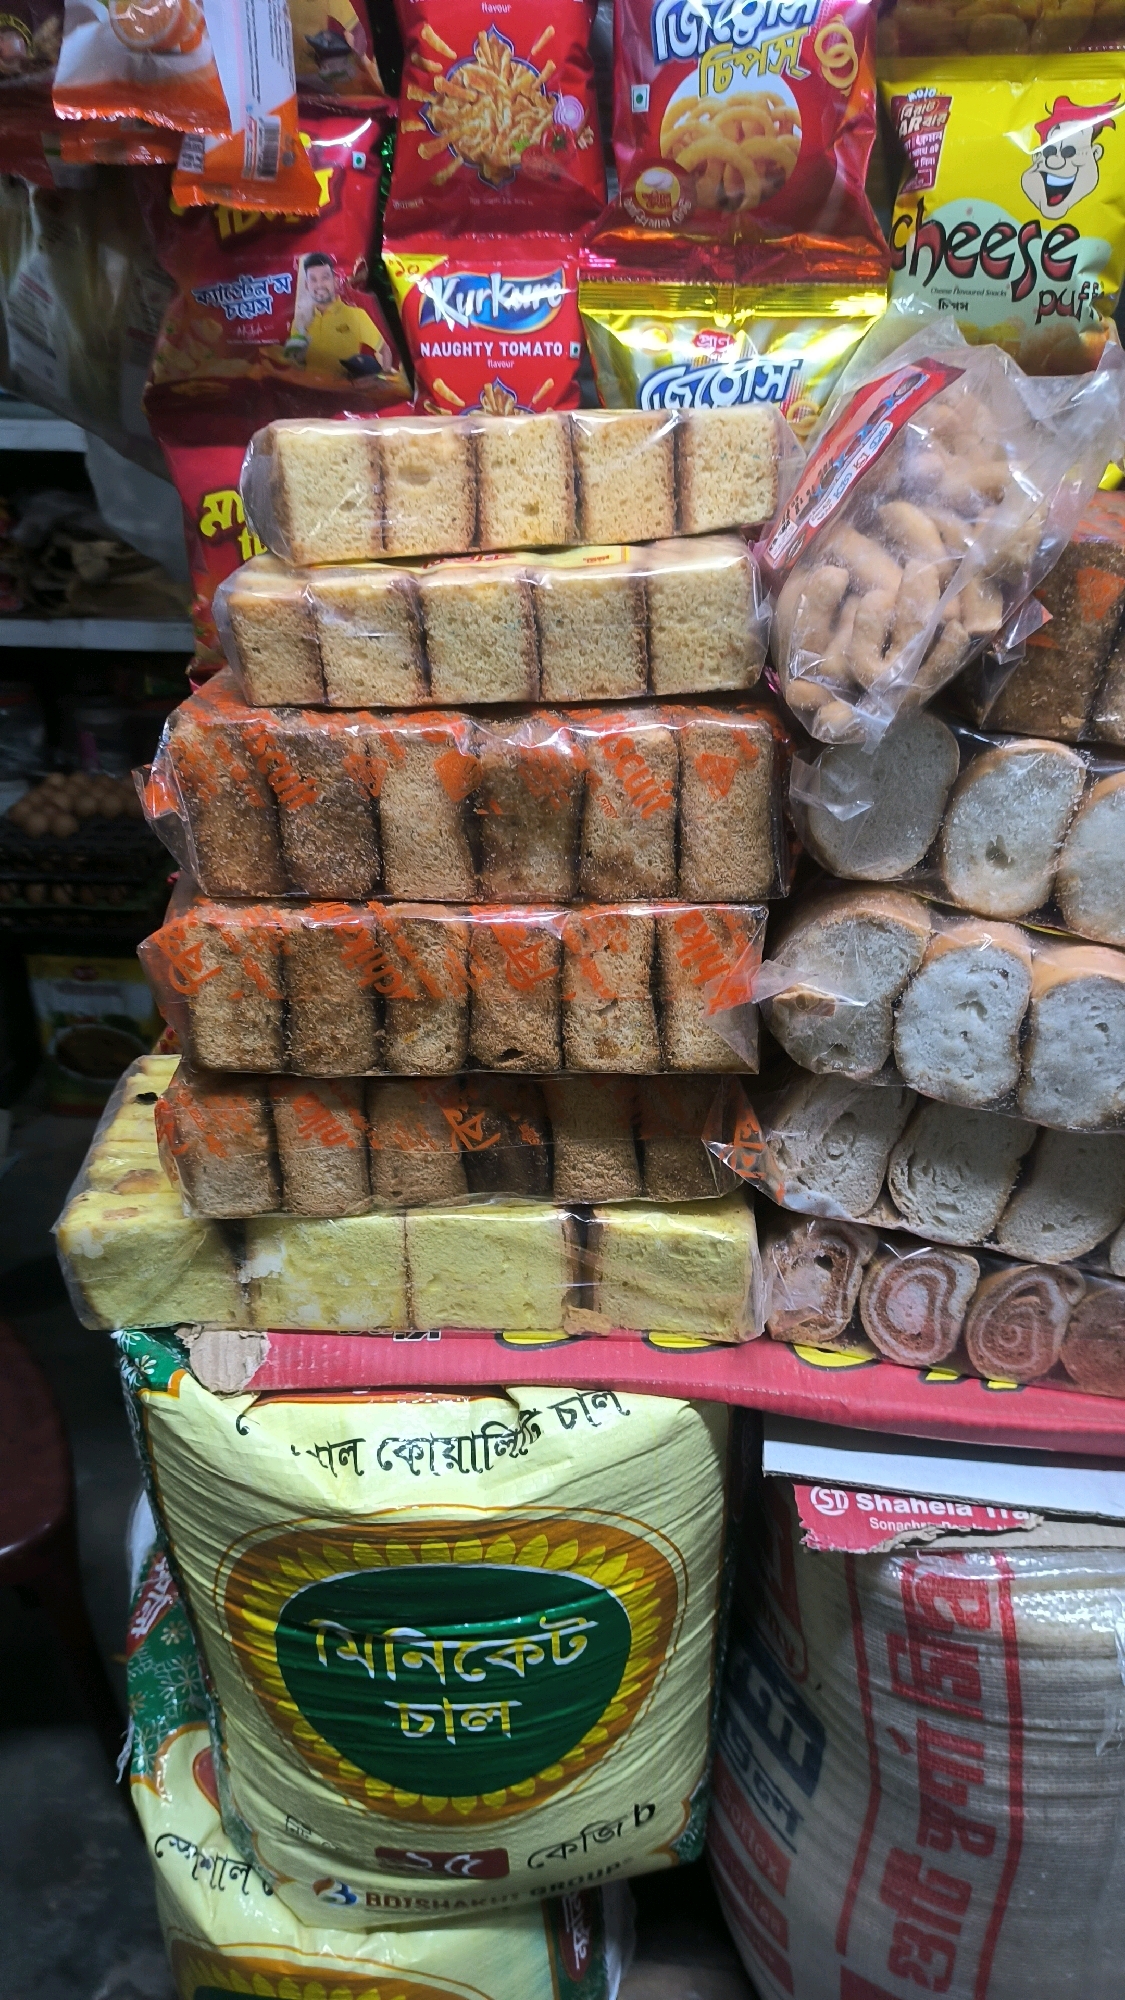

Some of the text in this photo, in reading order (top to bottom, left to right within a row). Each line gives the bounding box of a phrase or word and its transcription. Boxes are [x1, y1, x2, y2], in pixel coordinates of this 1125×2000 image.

[481, 2, 512, 13] flavour
[429, 272, 563, 330] Kurkure
[420, 341, 563, 357] NAUGHTY TOMATO
[486, 359, 515, 369] flavour
[308, 1616, 599, 1686] মিনিকেট
[384, 1697, 522, 1746] চাল
